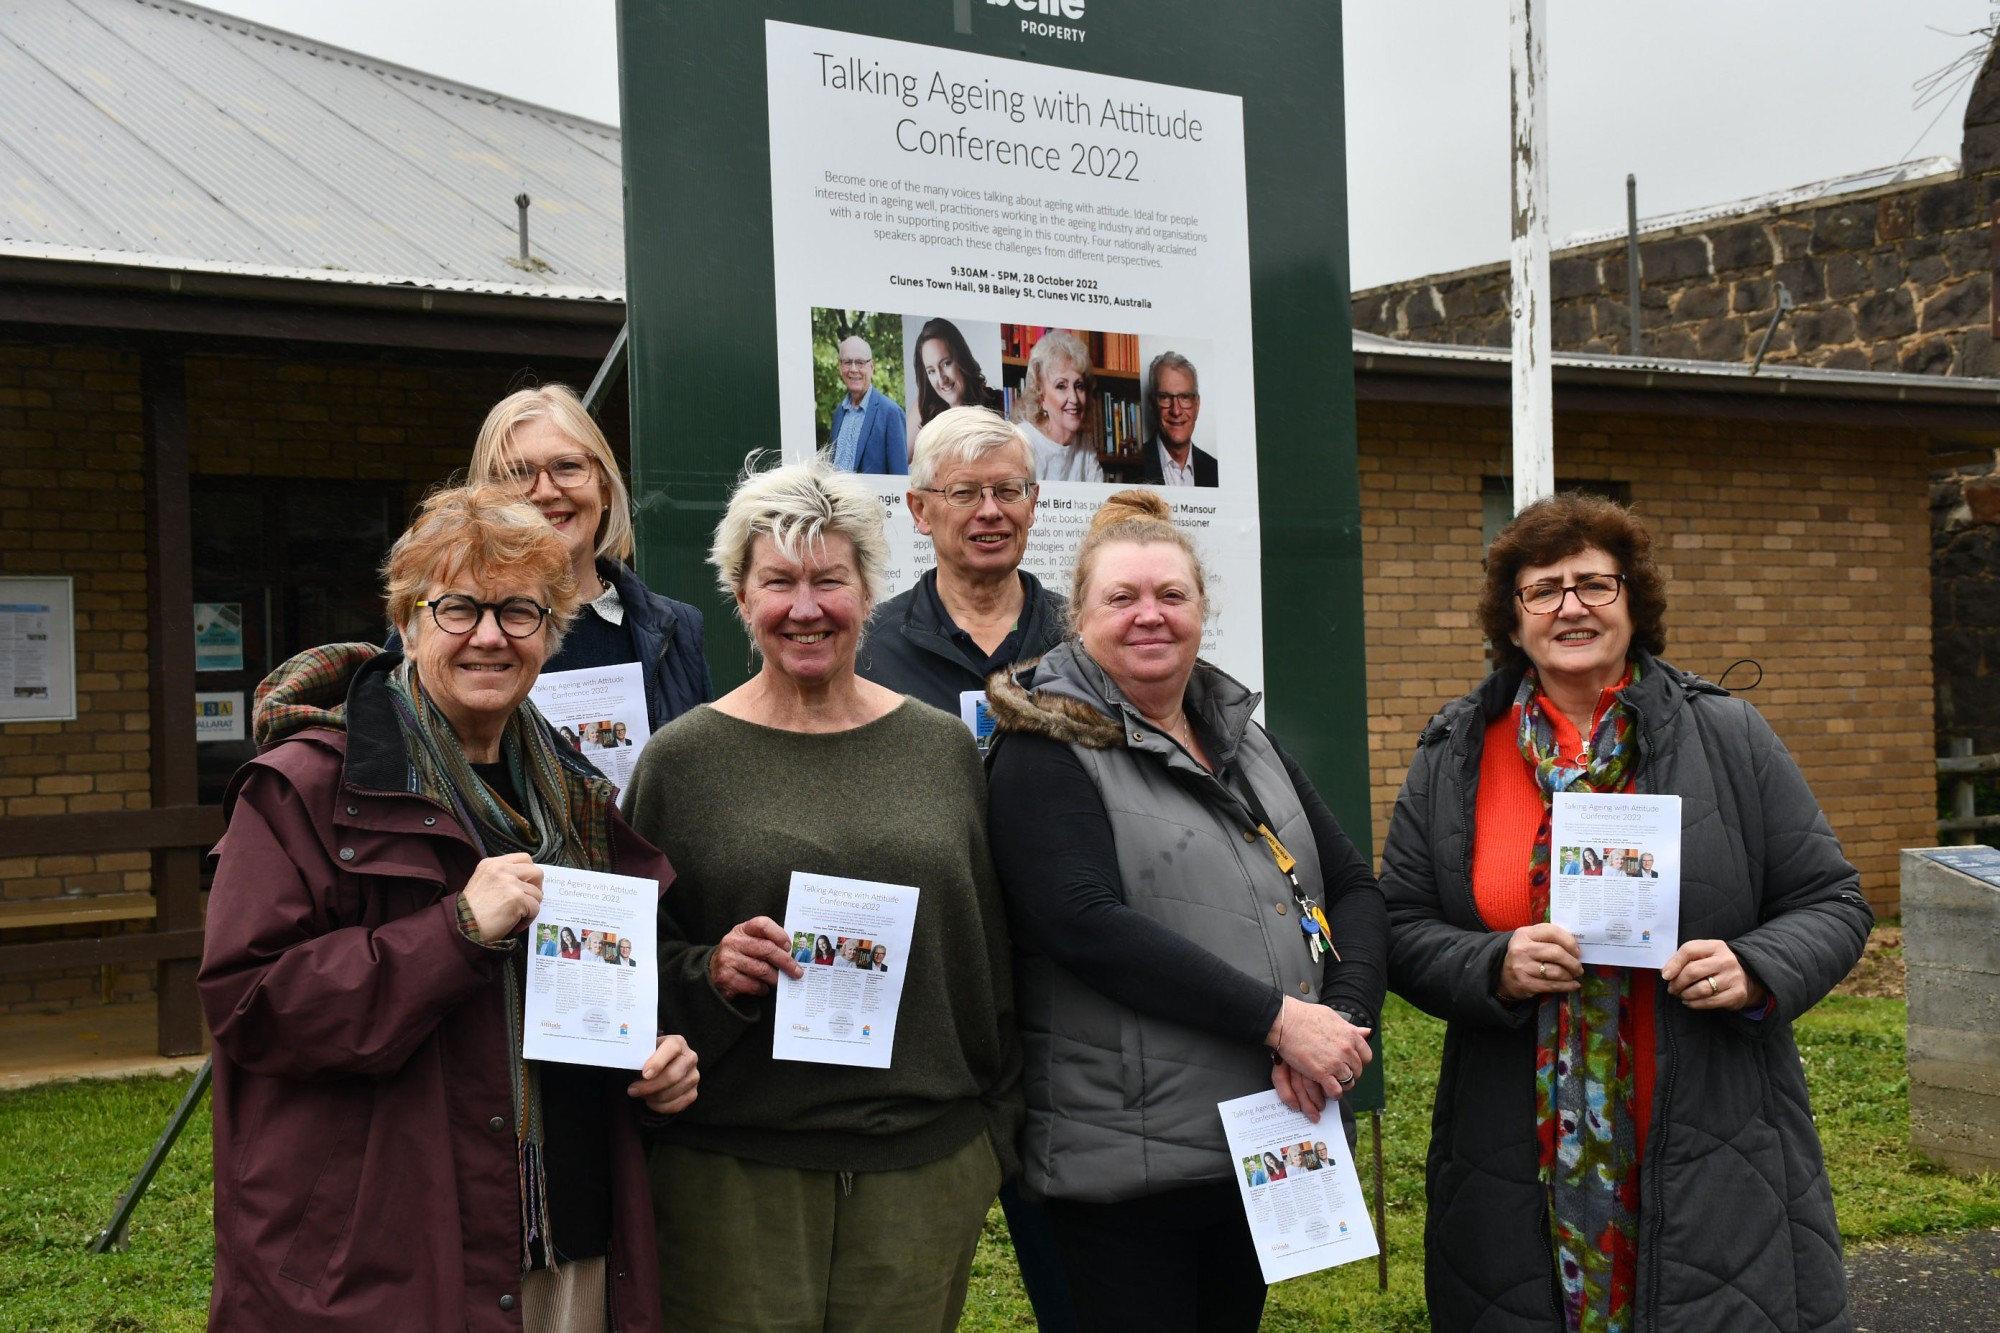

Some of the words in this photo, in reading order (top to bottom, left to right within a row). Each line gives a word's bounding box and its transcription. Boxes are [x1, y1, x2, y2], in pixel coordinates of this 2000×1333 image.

[1021, 20, 1086, 42] PROPERTY
[813, 52, 918, 108] Talking
[928, 71, 1026, 122] Ageing
[1033, 90, 1090, 126] with
[1100, 98, 1202, 142] Attitude
[896, 118, 1060, 170] Conference
[1071, 142, 1140, 182] 2022
[825, 172, 866, 187] Become
[869, 179, 888, 190] one
[891, 179, 901, 192] of
[904, 180, 920, 194] the
[924, 186, 949, 200] many
[951, 187, 981, 201] voices
[984, 190, 1014, 207] talking
[1016, 193, 1042, 208] about
[1044, 198, 1073, 214] ageing
[1075, 201, 1094, 214] with
[1096, 203, 1132, 218] attitude.
[1134, 207, 1154, 221] Ideal
[1156, 209, 1168, 222] for
[1170, 212, 1198, 228] people
[815, 186, 866, 203] interested
[869, 192, 878, 204] in
[881, 195, 913, 211] ageing
[915, 197, 937, 212] well,
[940, 202, 999, 218] practitioners
[1001, 208, 1037, 225] working
[1040, 211, 1048, 224] in
[1050, 212, 1065, 226] the
[1068, 216, 1096, 232] ageing
[1098, 218, 1133, 236] industry
[1135, 222, 1150, 235] and
[1153, 226, 1207, 242] organisations
[830, 205, 852, 218] with
[855, 210, 860, 219] a
[864, 208, 882, 222] role
[886, 211, 894, 223] in
[898, 215, 950, 232] supporting
[952, 219, 989, 233] positive
[992, 224, 1022, 240] ageing
[1024, 226, 1032, 238] in
[1036, 226, 1051, 240] this
[1054, 231, 1089, 246] country.
[1092, 233, 1111, 246] Four
[1114, 236, 1154, 254] nationally
[1157, 241, 1197, 256] acclaimed
[874, 227, 916, 242] speakers
[919, 233, 963, 246] approach
[966, 235, 992, 250] these
[995, 238, 1042, 257] challenges
[1044, 243, 1065, 257] from
[1068, 246, 1104, 262] different
[1107, 253, 1162, 268] perspectives.
[950, 266, 988, 279] 9:30AM
[998, 270, 1021, 283] 5PM,
[1023, 273, 1034, 283] 28
[1037, 274, 1074, 287] October
[1076, 278, 1098, 289] 2022
[890, 275, 924, 288] Clunes
[926, 279, 952, 290] Town
[955, 281, 976, 293] Hall,
[978, 283, 990, 294] 98
[992, 285, 1020, 299] Bailey
[1023, 287, 1035, 299] St,
[1037, 288, 1068, 301] Clunes
[1070, 292, 1086, 302] VIC
[1088, 293, 1112, 306] 3370,
[1114, 296, 1152, 308] Australia
[1054, 499, 1072, 509] Bird
[1074, 501, 1087, 510] has
[1180, 504, 1216, 514] Mansour
[1060, 514, 1083, 524] books
[1053, 530, 1064, 538] on
[1028, 542, 1064, 554] thologies
[534, 684, 556, 692] Talking
[558, 682, 580, 690] Ageing
[598, 676, 624, 684] Attitude
[552, 690, 590, 700] Conference
[592, 686, 608, 695] 2022
[197, 720, 232, 728] ALLARAT
[1564, 802, 1586, 812] Talking
[1588, 804, 1612, 812] Ageing
[1631, 804, 1660, 812] Attitude
[545, 876, 566, 888] alking
[567, 880, 592, 890] Ageing
[592, 882, 609, 892] with
[610, 885, 638, 896] Attitude
[804, 884, 826, 896] Talking
[828, 888, 852, 900] Ageing
[854, 892, 870, 900] with
[871, 894, 900, 904] Attitude
[559, 888, 600, 900] Conference
[602, 893, 620, 904] 2022
[820, 896, 860, 908] Conference
[862, 902, 880, 912] 2022
[1232, 1109, 1254, 1118] Talking
[1255, 1104, 1276, 1114] Ageing
[1250, 1112, 1286, 1124] Conference
